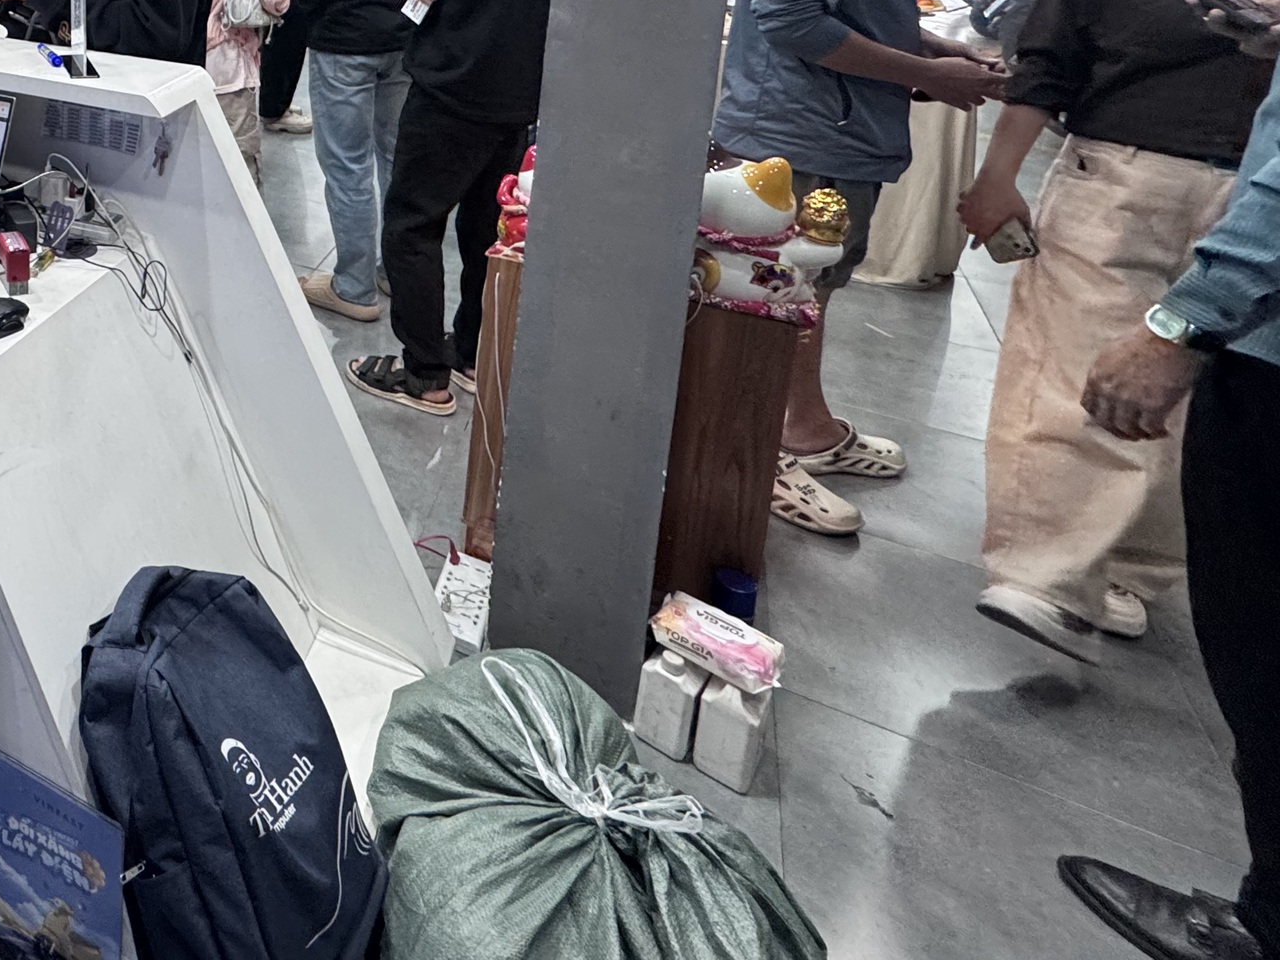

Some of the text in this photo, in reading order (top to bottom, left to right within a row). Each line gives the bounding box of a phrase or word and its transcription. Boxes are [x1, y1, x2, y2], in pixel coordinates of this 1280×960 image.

[696, 609, 746, 640] TOP GIA
[665, 626, 714, 659] TOP GIA
[262, 753, 314, 814] Hanh
